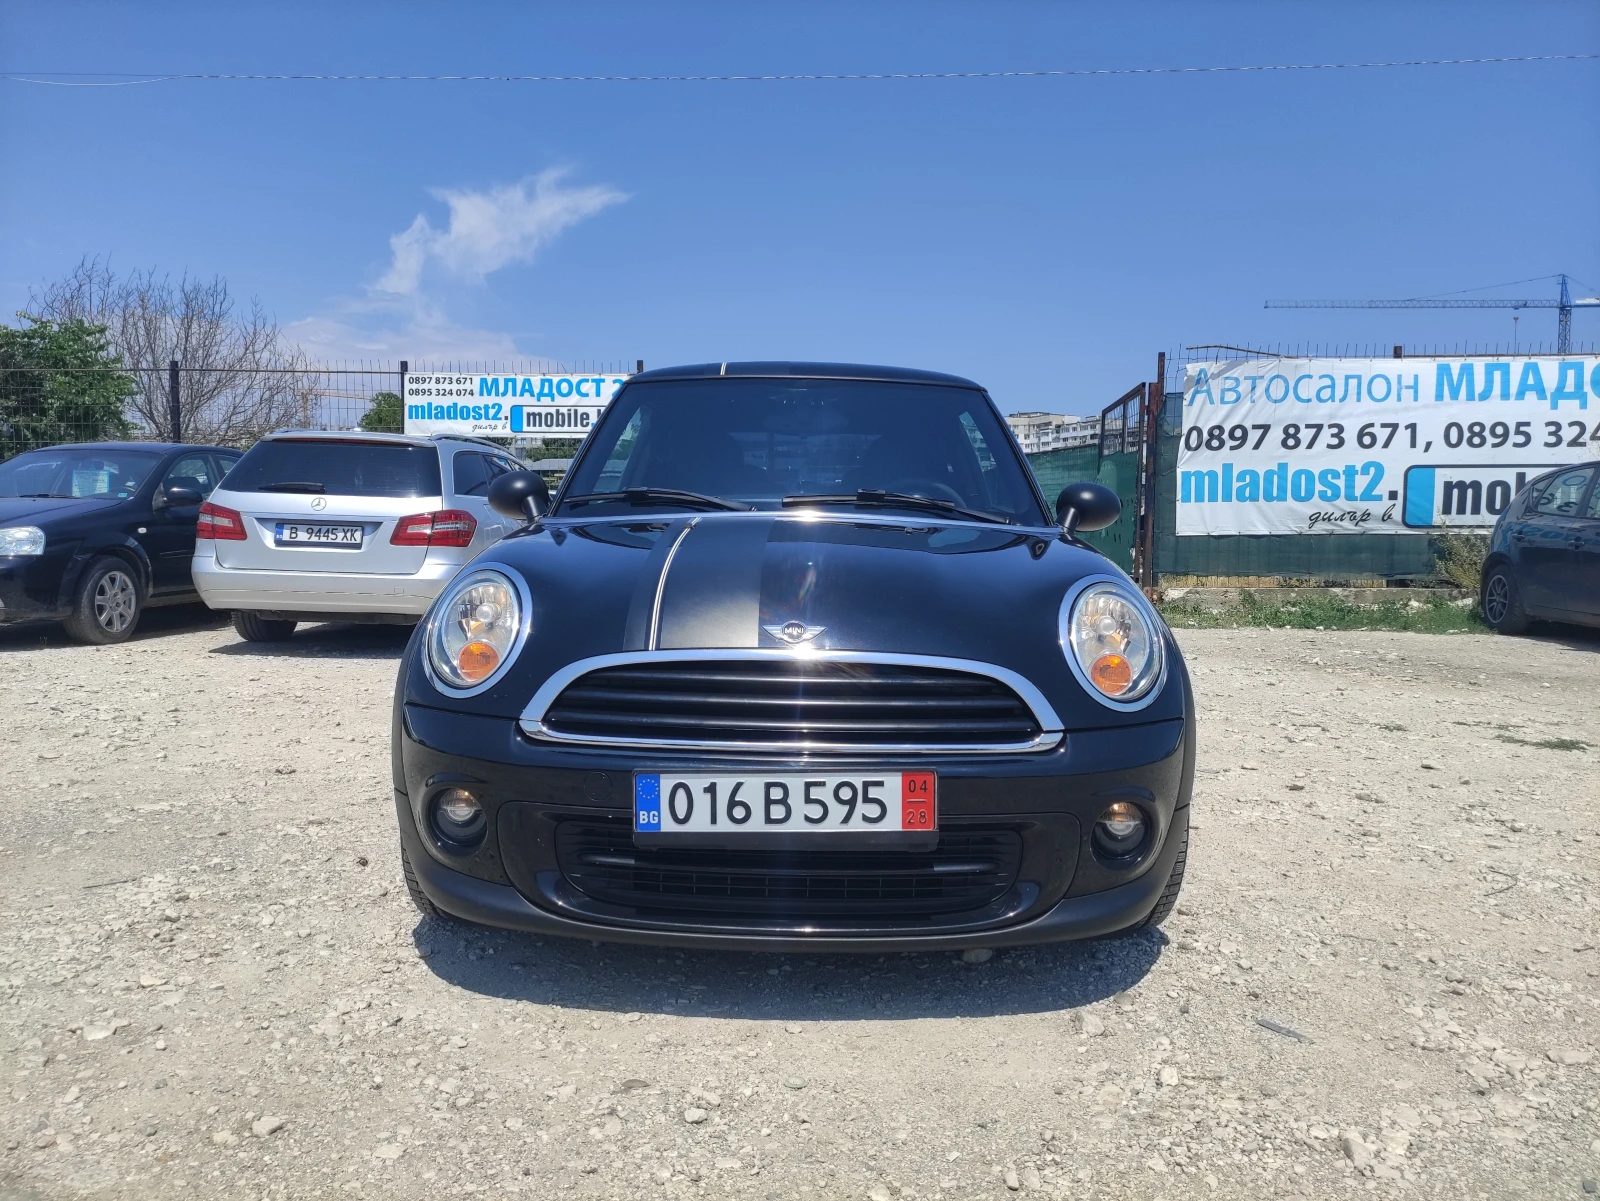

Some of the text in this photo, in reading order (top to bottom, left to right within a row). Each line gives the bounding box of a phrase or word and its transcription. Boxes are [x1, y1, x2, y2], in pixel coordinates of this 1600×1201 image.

[408, 376, 474, 386] 0897 873 671
[1187, 361, 1600, 411] Автосалон МЛАД
[408, 388, 474, 397] 0895 324 074
[478, 377, 606, 402] МЛАДОСТ
[1184, 423, 1271, 452] 0897
[1280, 422, 1346, 451] 873
[1356, 422, 1433, 453] 671,
[1443, 420, 1532, 449] 0895
[784, 626, 804, 635] MINI
[908, 779, 928, 794] 04
[640, 810, 659, 824] BG
[906, 810, 928, 826] 28
